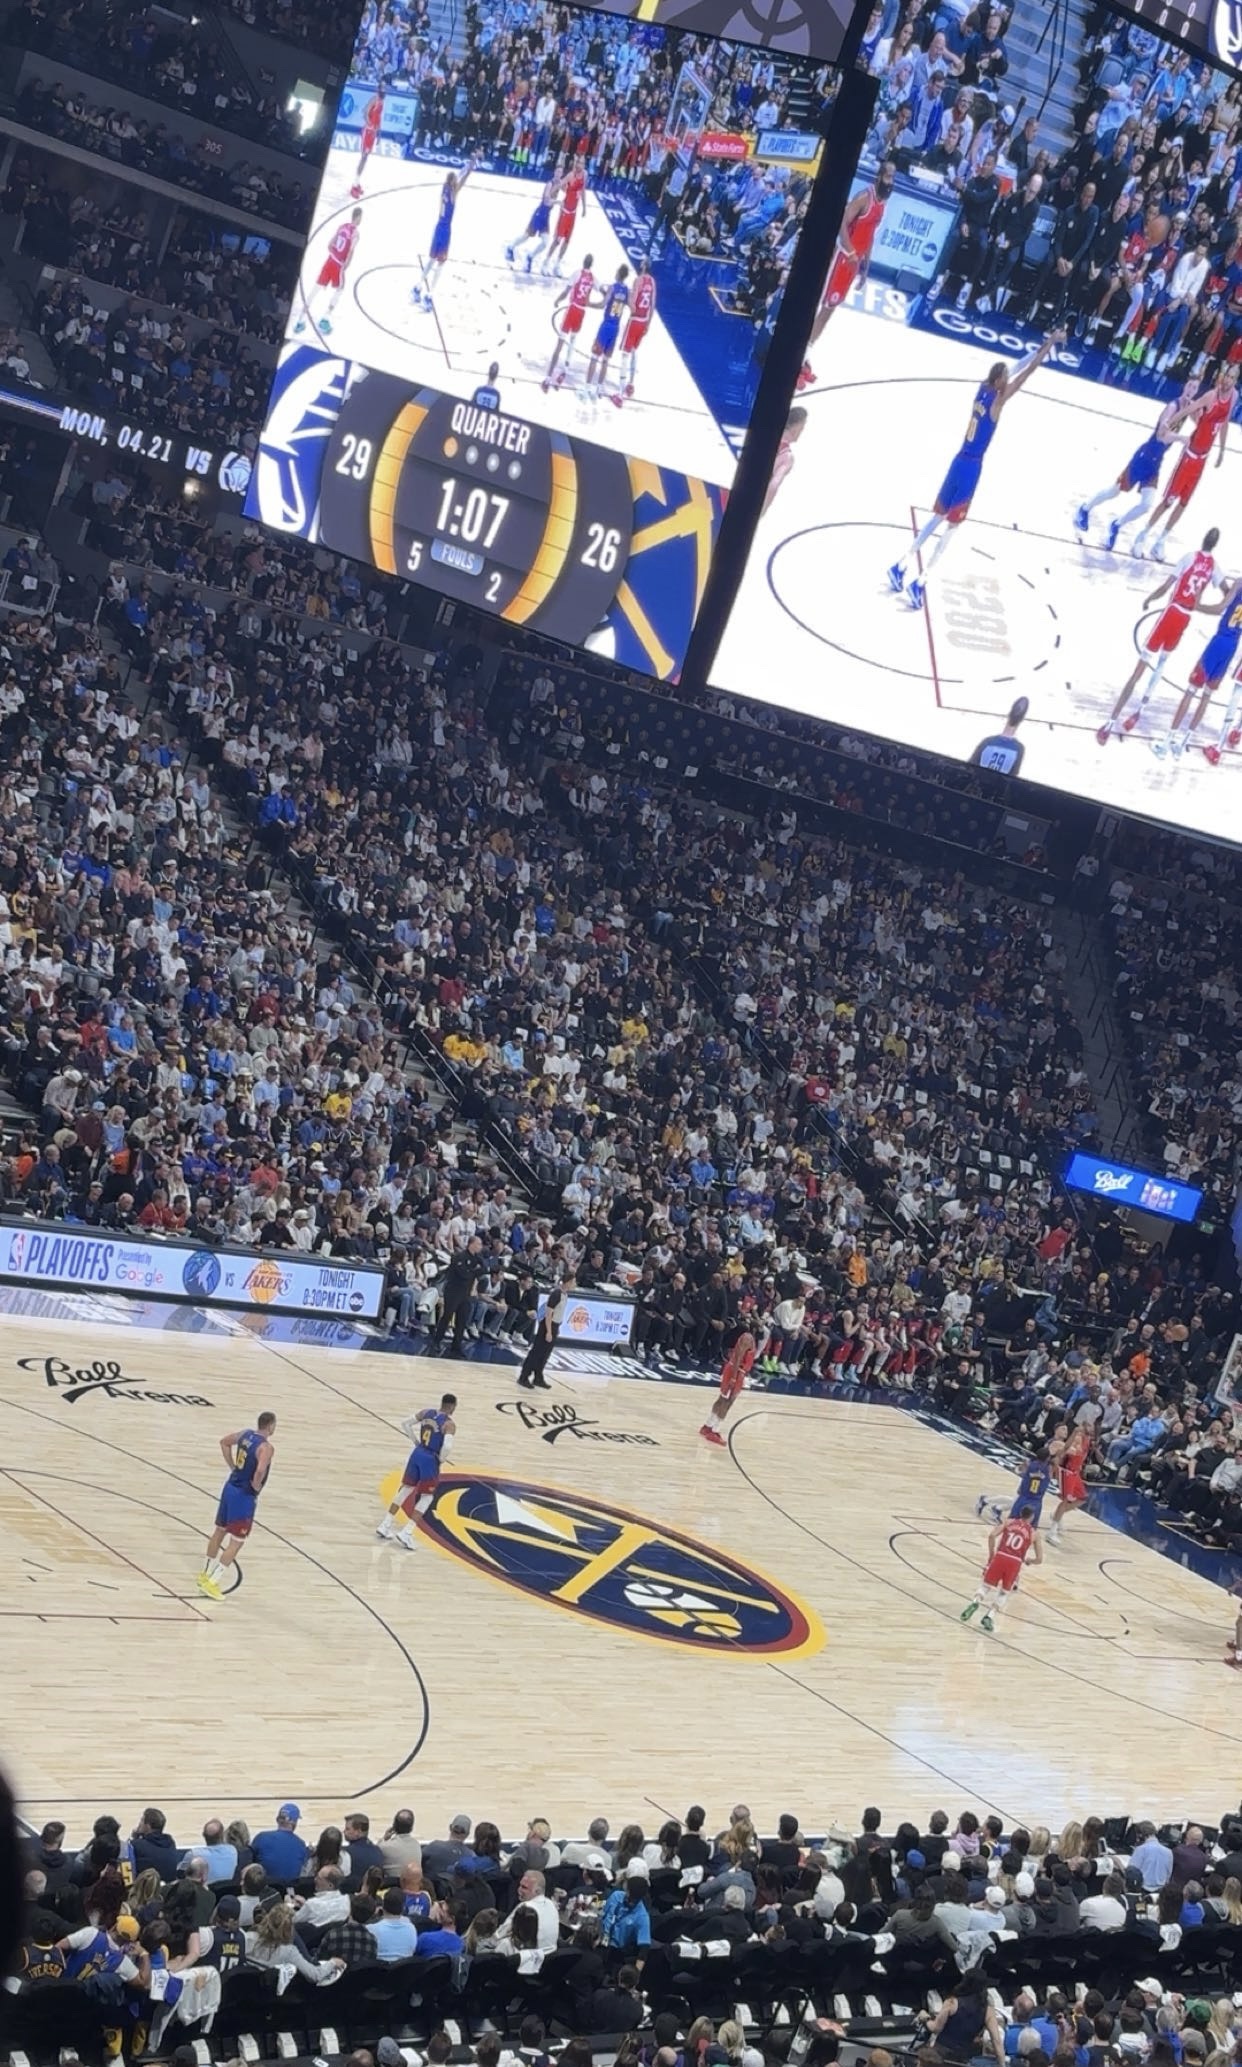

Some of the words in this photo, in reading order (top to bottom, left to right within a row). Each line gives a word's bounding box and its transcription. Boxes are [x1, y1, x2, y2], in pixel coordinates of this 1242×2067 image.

[204, 138, 223, 154] 305
[899, 211, 934, 238] TONIGHT
[59, 406, 108, 447] MON,
[117, 425, 173, 463] 04.21
[184, 446, 213, 475] VS
[450, 403, 532, 455] QUARTER
[335, 434, 373, 480] 29
[436, 478, 510, 549] 1:07
[406, 541, 424, 571] 5
[440, 542, 476, 571] FOULS
[580, 522, 622, 573] 26
[484, 571, 502, 603] 2
[1094, 1170, 1134, 1192] Ball
[24, 1235, 115, 1282] PLAYOFFS
[115, 1263, 164, 1288] Google
[241, 1269, 294, 1296] LAKERS
[317, 1268, 356, 1289] TONIGHT
[302, 1288, 336, 1310] 8:30PM
[337, 1292, 349, 1310] ET
[17, 1356, 147, 1392] Ball
[101, 1383, 215, 1408] Arena
[496, 1401, 599, 1433] Ball
[568, 1425, 662, 1446] Arena
[1005, 1532, 1024, 1551] 10
